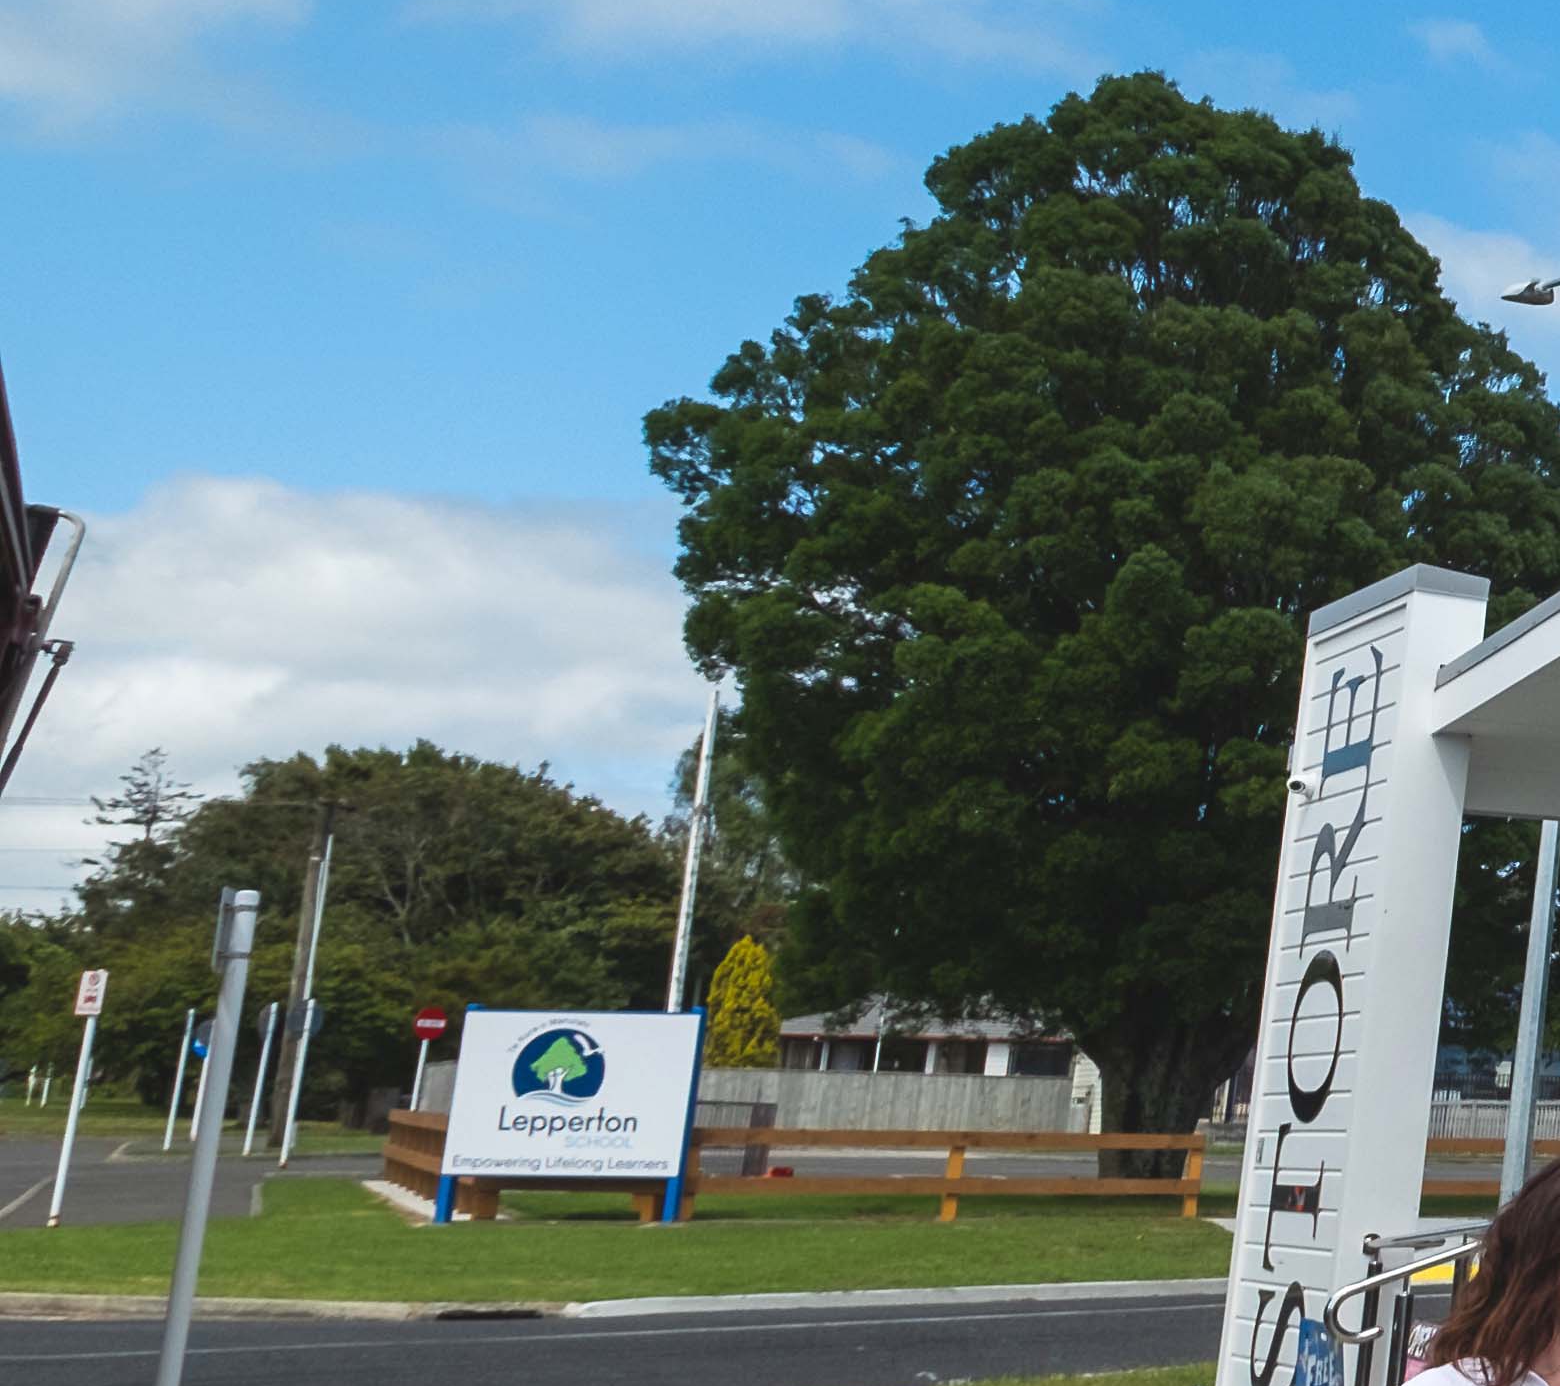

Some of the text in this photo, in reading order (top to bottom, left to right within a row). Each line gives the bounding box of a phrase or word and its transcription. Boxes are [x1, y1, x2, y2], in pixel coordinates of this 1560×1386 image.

[498, 1104, 638, 1137] Lepperton
[564, 1135, 634, 1150] SCHOOL
[452, 1154, 668, 1172] Empowering Lifelong Learners
